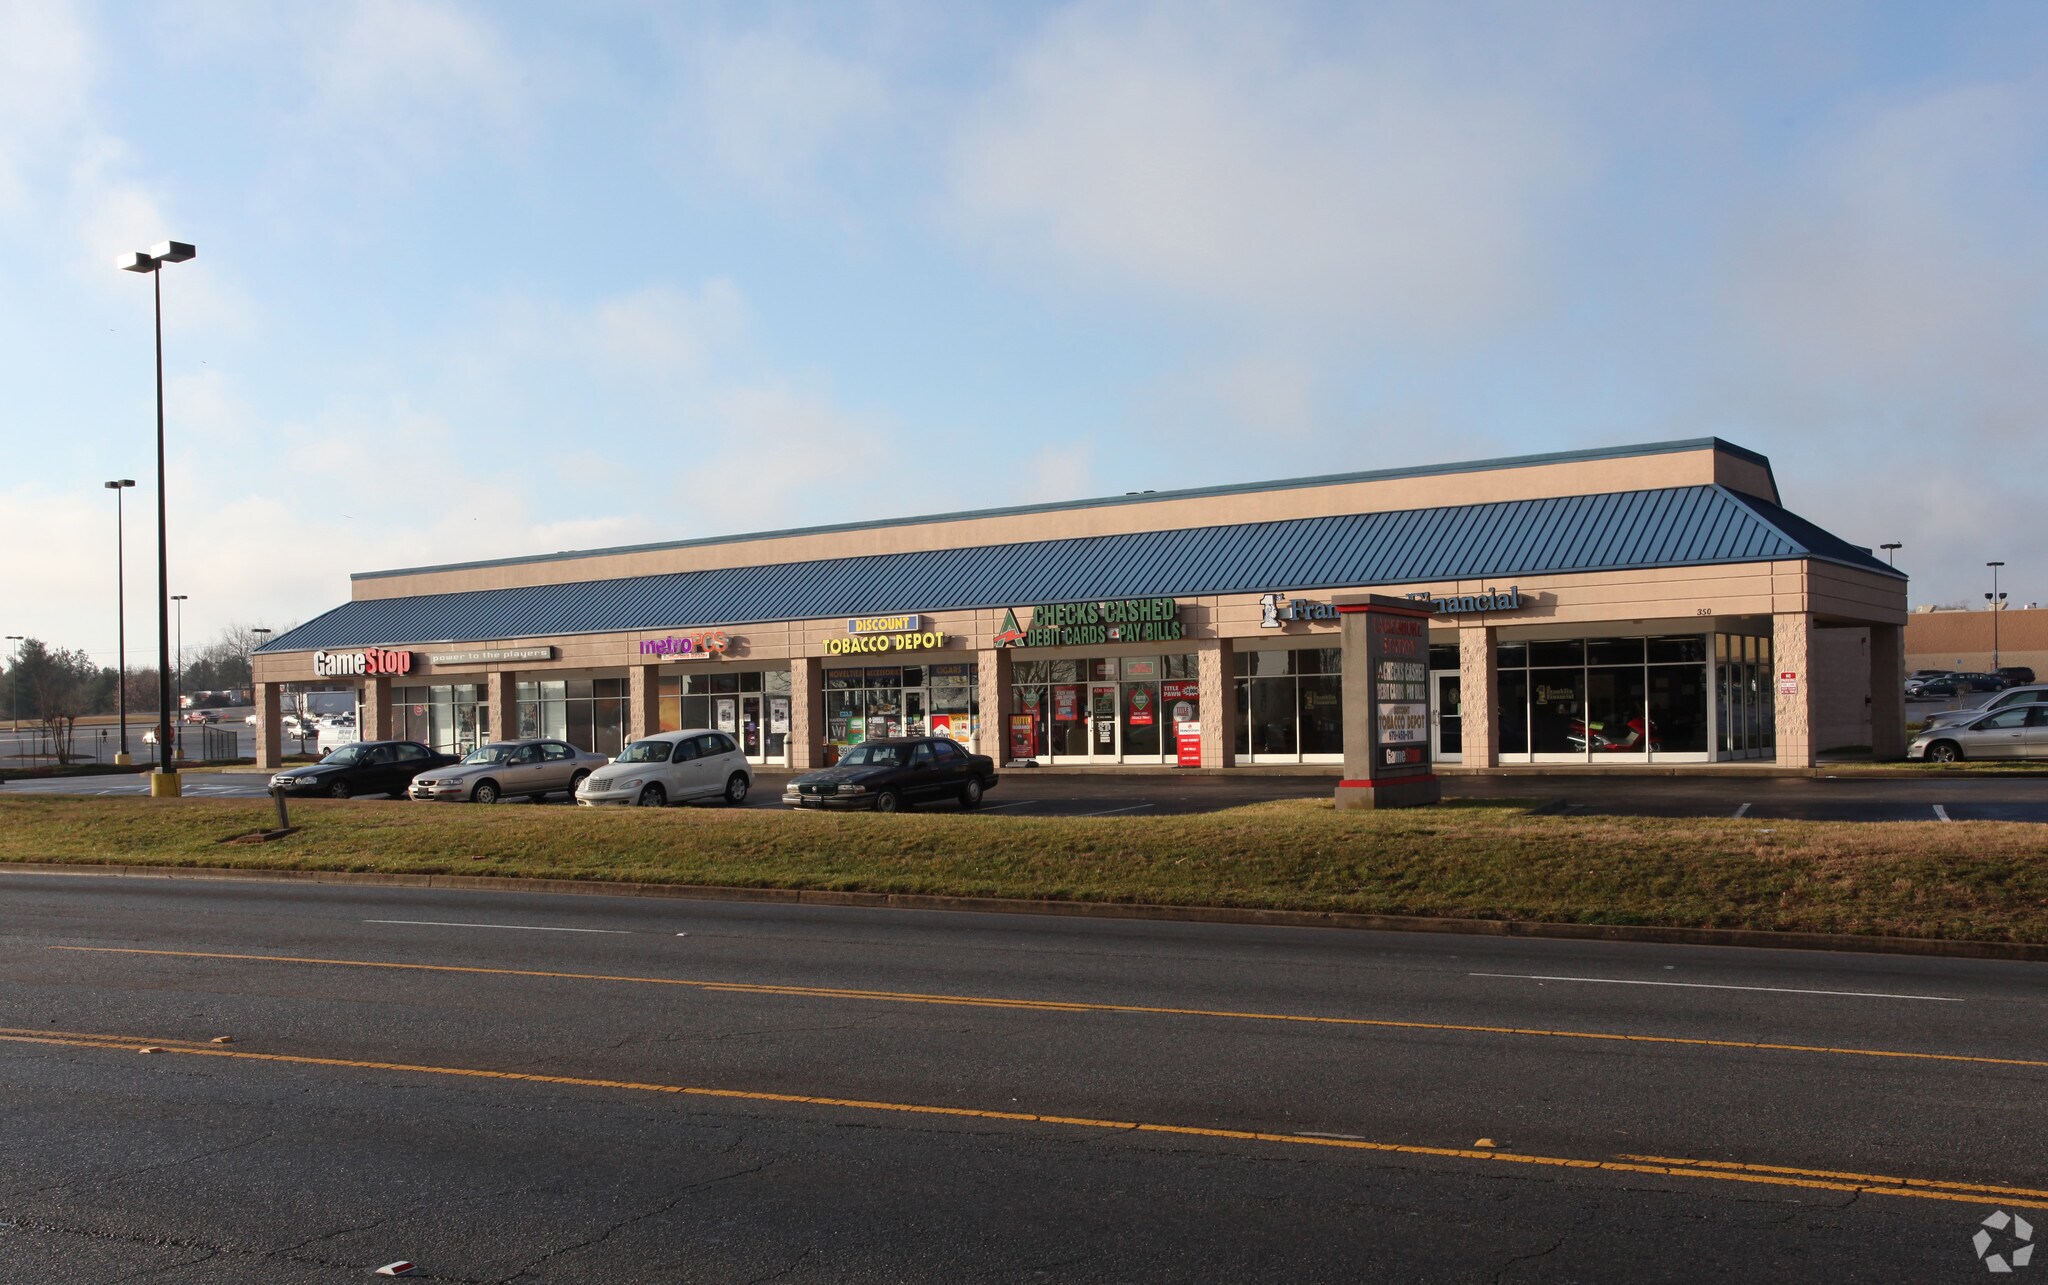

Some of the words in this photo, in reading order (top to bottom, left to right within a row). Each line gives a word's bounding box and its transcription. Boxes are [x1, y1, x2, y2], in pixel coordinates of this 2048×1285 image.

[1033, 602, 1100, 627] CHECKS
[1104, 598, 1175, 622] CASHED
[1290, 599, 1341, 620] Fran
[1407, 586, 1519, 613] nancial
[1697, 608, 1711, 616] 350
[856, 617, 909, 631] DISCOUNT
[1028, 627, 1060, 647] DEBIT
[1065, 625, 1107, 645] CARDS
[1119, 623, 1144, 642] PAY
[1146, 621, 1181, 641] BILLS
[640, 631, 727, 654] metroPCS
[822, 635, 889, 654] TOBACCO
[896, 632, 944, 650] DEPOT
[314, 648, 411, 676] GameStop
[433, 654, 465, 662] power
[503, 650, 548, 659] players
[1012, 717, 1030, 725] AUTO
[1379, 715, 1405, 729] TOBACCO
[1407, 715, 1424, 729] DEPOT
